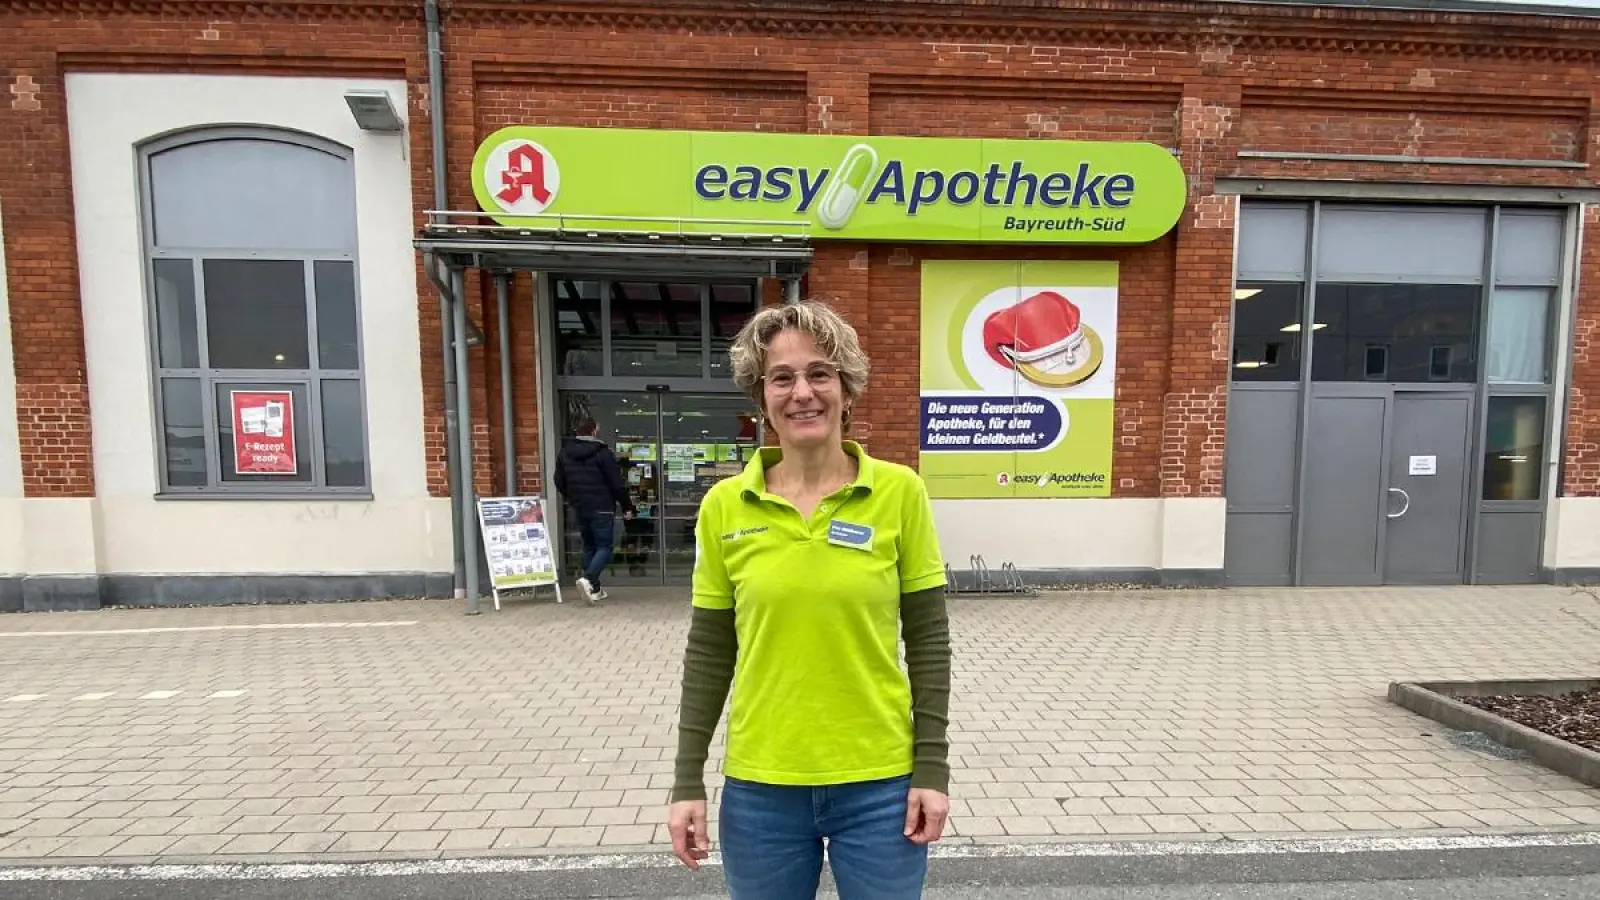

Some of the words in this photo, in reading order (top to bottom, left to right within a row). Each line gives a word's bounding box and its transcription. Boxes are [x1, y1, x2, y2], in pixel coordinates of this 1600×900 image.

[695, 163, 829, 213] easy
[866, 160, 1135, 216] Apotheke
[1003, 217, 1126, 233] Bayreuth-Süd
[927, 402, 947, 414] Die
[949, 403, 978, 414] neue
[981, 402, 1045, 415] Generation
[927, 418, 985, 431] Apotheke,
[988, 417, 1005, 429] für
[1007, 418, 1032, 429] den
[927, 433, 970, 445] kleinen
[245, 442, 284, 452] E-Rezept
[252, 453, 278, 464] ready
[1013, 475, 1041, 484] easy
[1050, 472, 1105, 483] Apotheke
